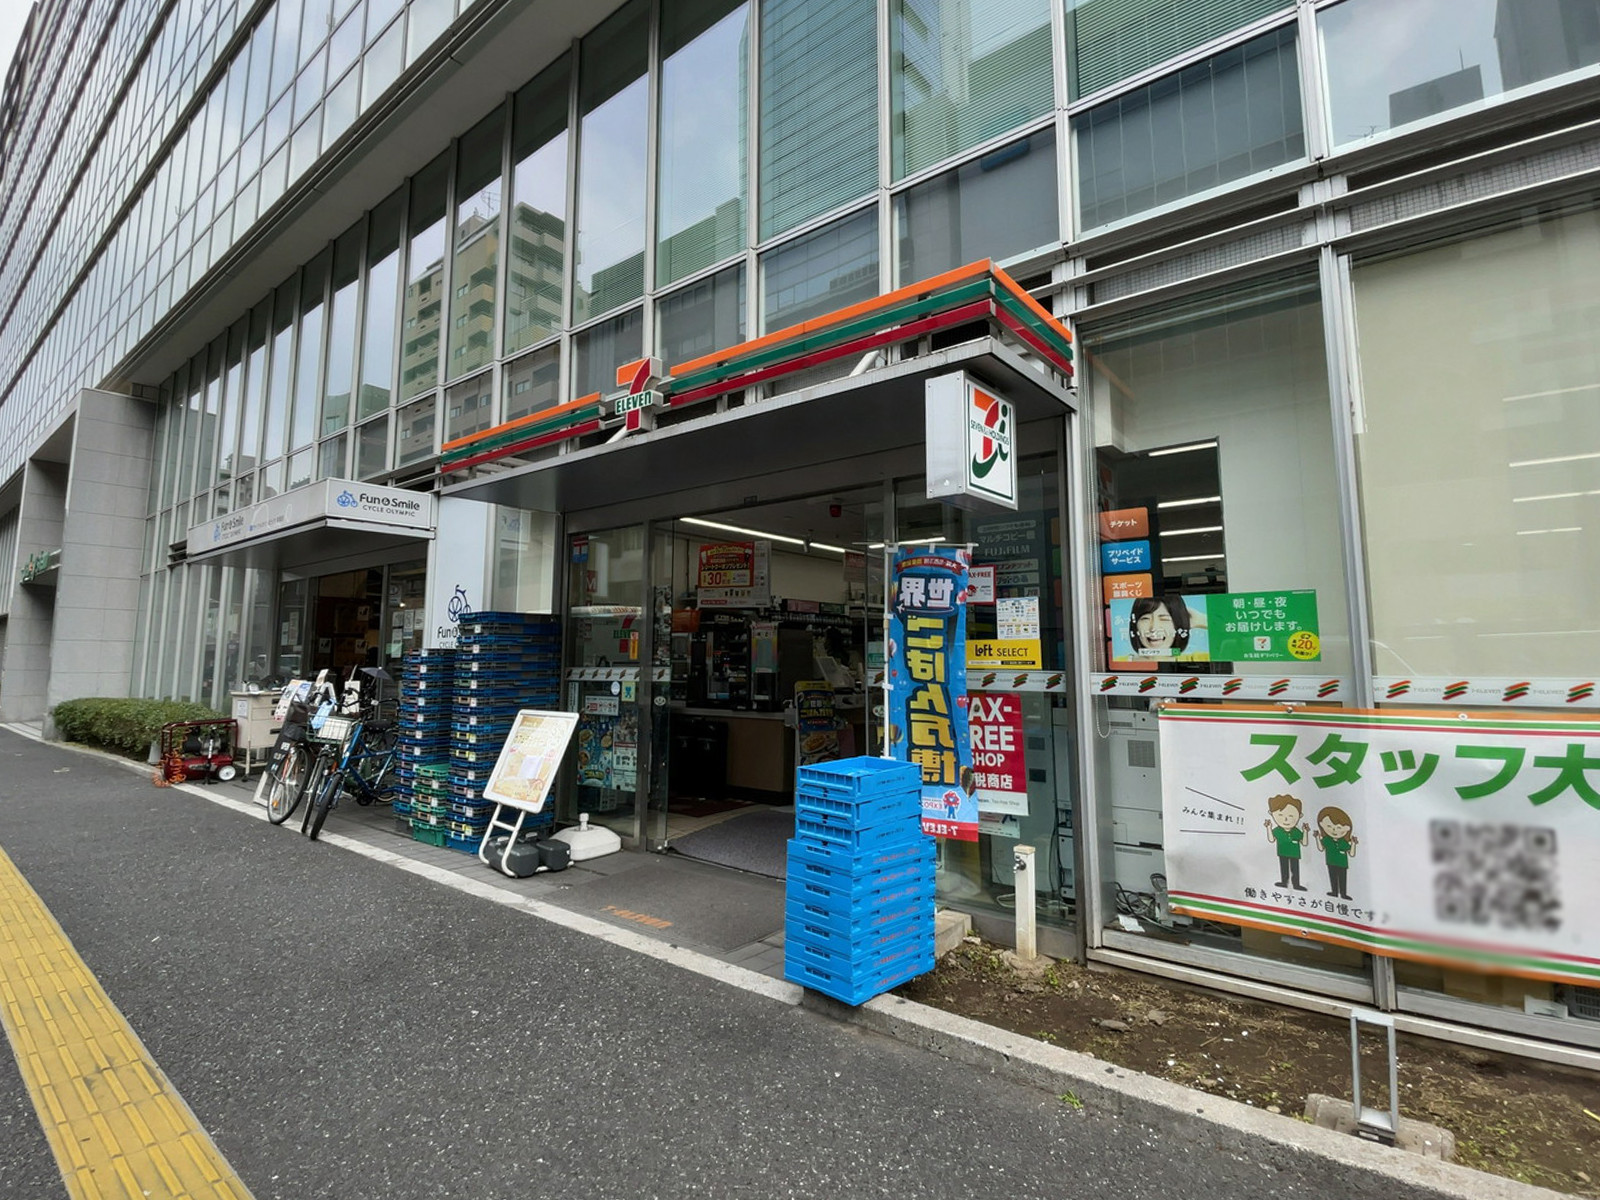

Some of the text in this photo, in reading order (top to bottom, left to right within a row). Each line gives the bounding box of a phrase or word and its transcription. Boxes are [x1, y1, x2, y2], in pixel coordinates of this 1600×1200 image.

[616, 357, 651, 432] 7
[359, 492, 381, 504] Fun
[391, 497, 421, 512] Smile
[362, 504, 416, 517] CYCLE OLYMPIC
[1109, 518, 1138, 528] チケット
[984, 544, 1031, 557] FUJIFILM
[1107, 547, 1144, 557] プリペイド
[1111, 556, 1142, 565] サービス
[1112, 581, 1143, 590] スポーツ
[1232, 596, 1288, 609] 朝・昼・夜
[1235, 609, 1286, 620] いつでも
[1225, 620, 1303, 632] お届けします。
[996, 647, 1029, 657] SELECT
[967, 696, 1013, 723] AX-
[969, 724, 1016, 752] REE
[1240, 732, 1600, 811] スタッフ大
[974, 771, 1013, 790] 税商店
